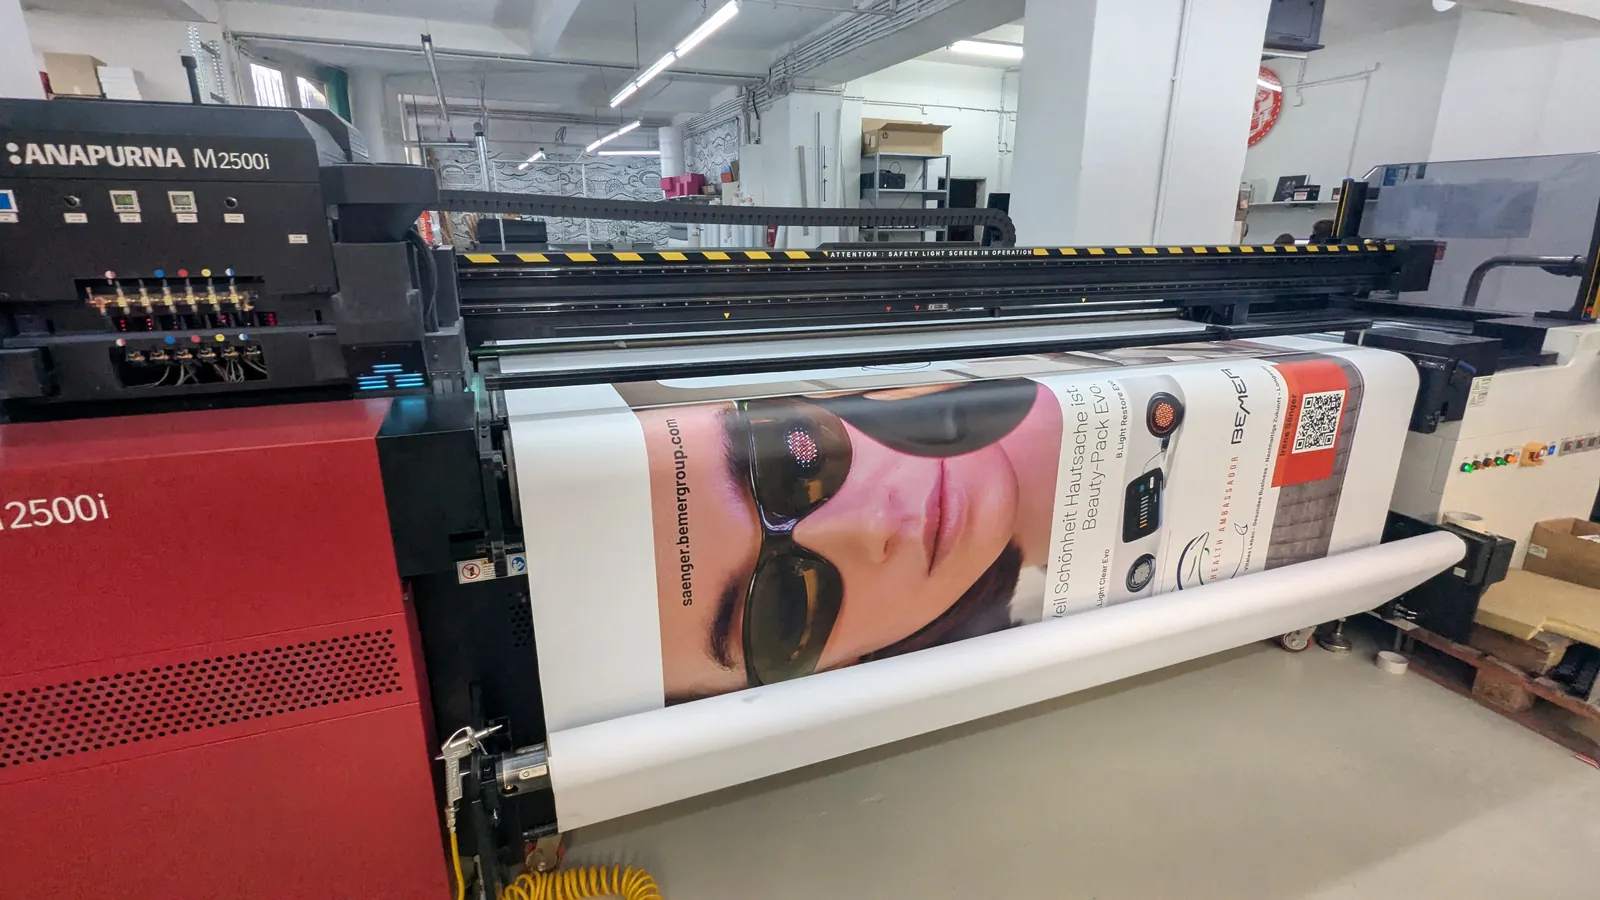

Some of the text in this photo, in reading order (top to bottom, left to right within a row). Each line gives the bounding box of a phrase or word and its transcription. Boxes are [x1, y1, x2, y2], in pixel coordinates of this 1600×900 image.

[1066, 385, 1086, 407] ist.
[1117, 392, 1128, 426] Restore
[1064, 411, 1089, 507] Hautsache
[1116, 427, 1127, 459] B.Light
[1259, 467, 1268, 496] Business
[1265, 424, 1277, 463] Nachhaltige
[1273, 397, 1282, 423] Zukunft
[1280, 431, 1290, 457] Irene
[1082, 418, 1110, 531] Beauty-Pack
[0, 493, 109, 530] 2500i
[665, 418, 694, 606] saenger.bemergroup.com
[1210, 456, 1239, 580] HEALTH AMBASSADOR
[1054, 510, 1078, 594] Schönheit
[1102, 549, 1110, 563] Evo
[1099, 565, 1108, 586] Clear
